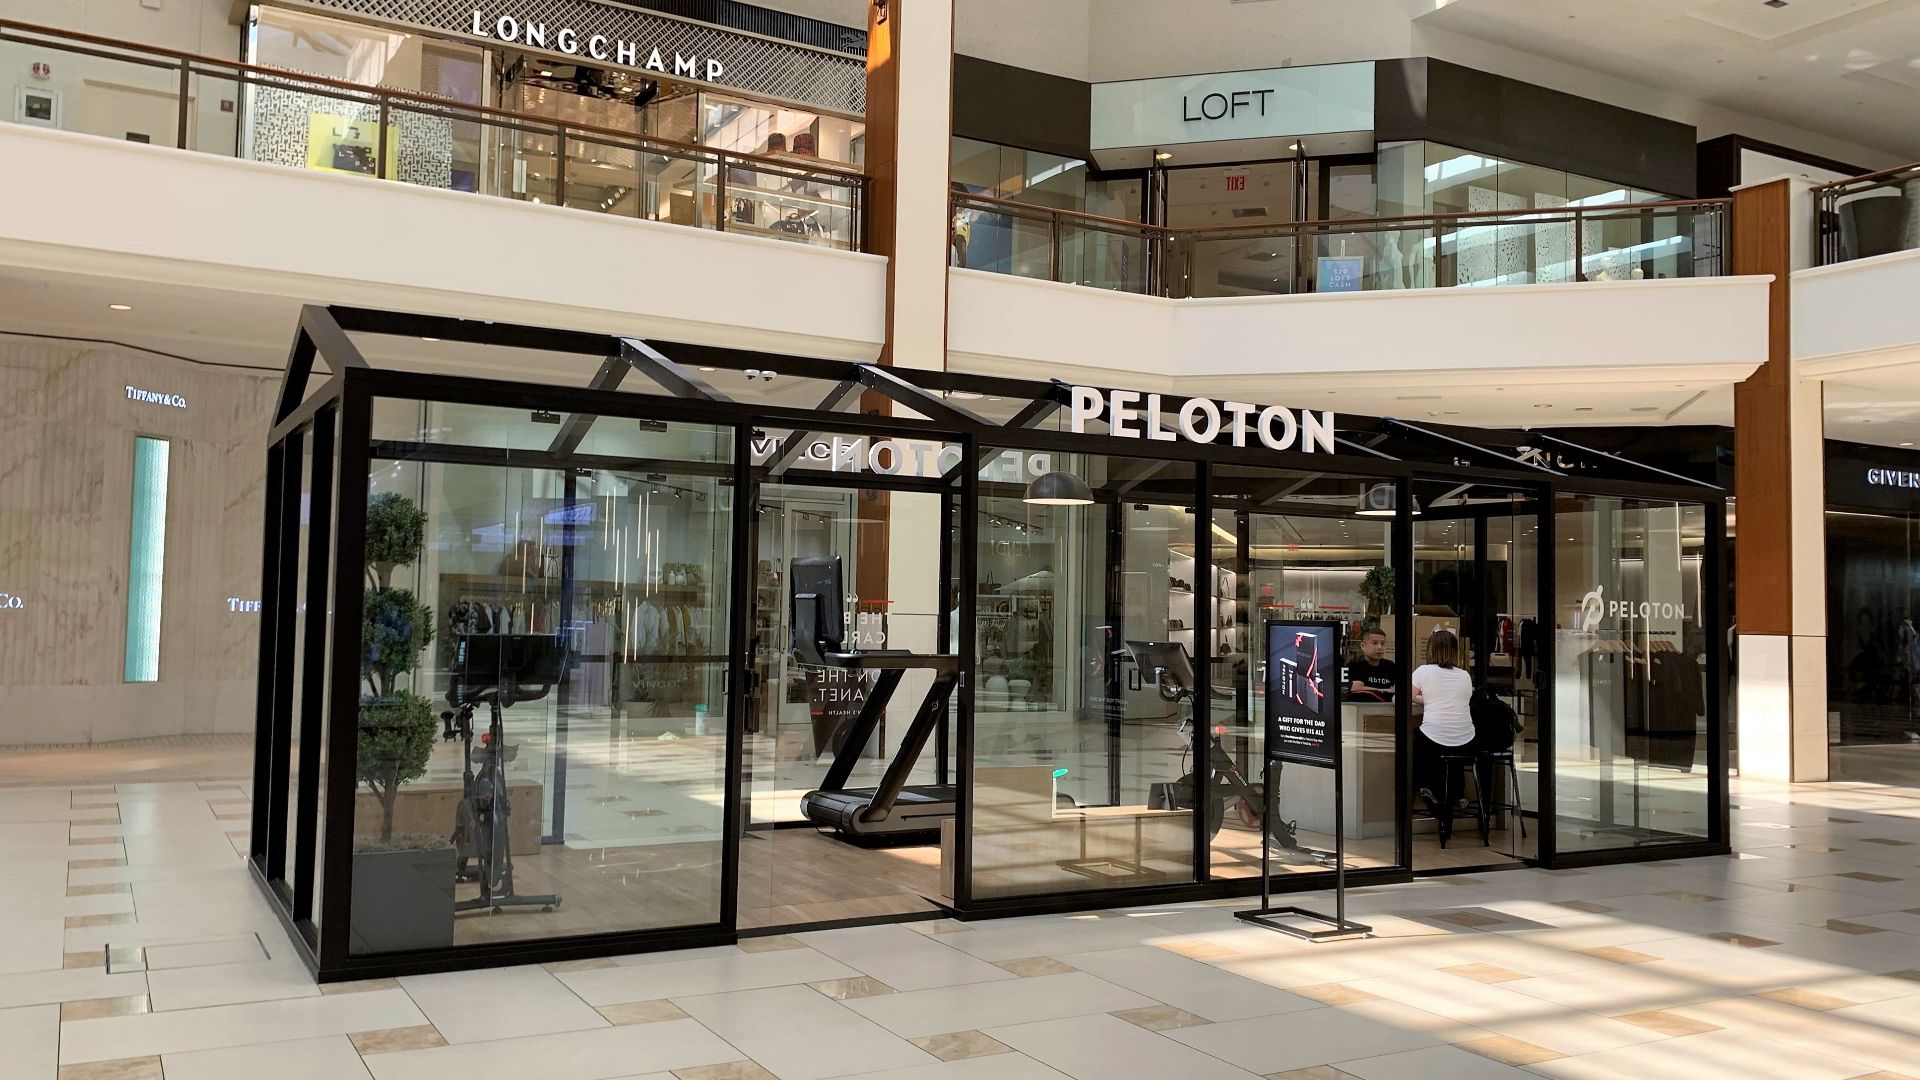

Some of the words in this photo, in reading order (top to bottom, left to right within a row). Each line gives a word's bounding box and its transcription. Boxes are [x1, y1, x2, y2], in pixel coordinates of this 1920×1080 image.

[472, 10, 724, 82] LONGCHAMP
[1183, 89, 1275, 121] LOFT
[1071, 385, 1335, 455] PELOTON
[1609, 600, 1685, 620] PELOTON
